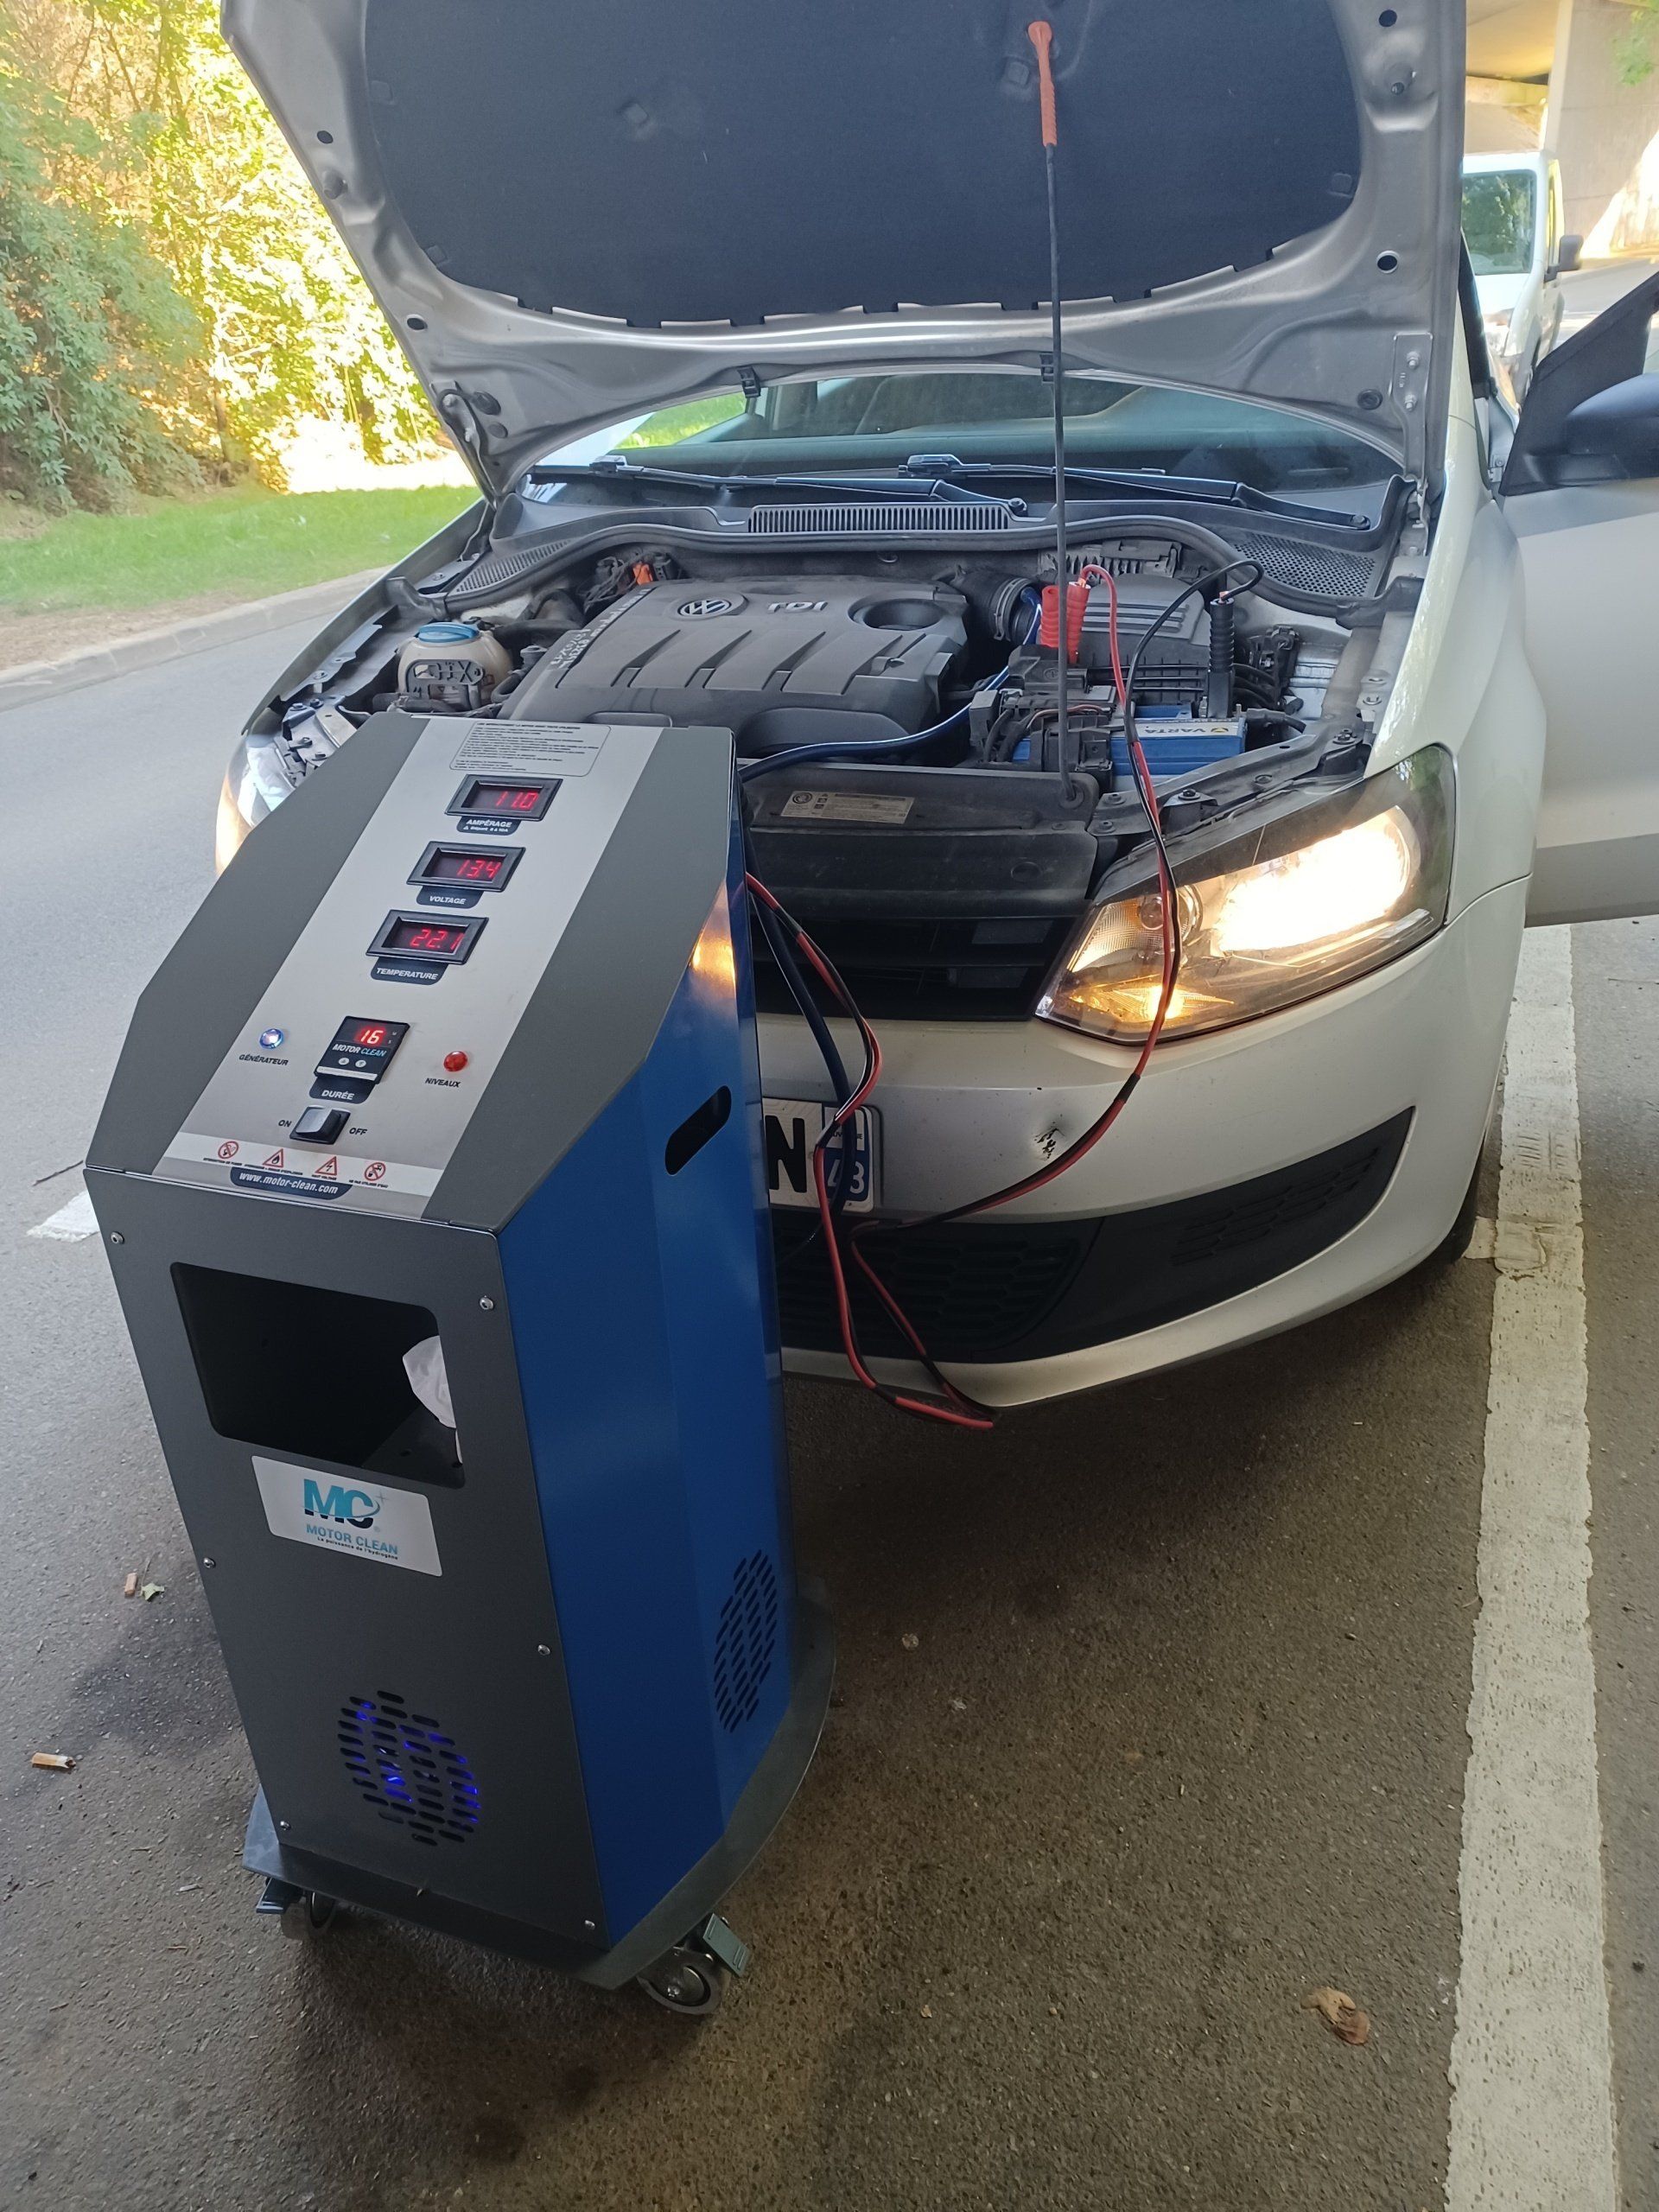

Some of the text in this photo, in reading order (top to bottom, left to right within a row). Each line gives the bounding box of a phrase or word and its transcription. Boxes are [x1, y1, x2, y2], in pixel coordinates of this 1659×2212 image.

[767, 601, 828, 613] TDI
[466, 819, 512, 828] AMPÉRAGE
[429, 895, 467, 905] VOLTAGE
[410, 928, 465, 950] 22.1
[376, 968, 439, 981] TEMPERATURE
[360, 1029, 385, 1045] 16
[332, 1043, 387, 1057] MOTOR CLEAN
[238, 1053, 289, 1065] GÉNÉRATEUR
[424, 1077, 461, 1087] NIVEAUX
[321, 1090, 355, 1100] DURÉE
[348, 1127, 368, 1135] OFF
[238, 1173, 339, 1194] www.motor-clean.com
[303, 1478, 375, 1529] MC
[306, 1523, 398, 1555] MOTOR CLEAN
